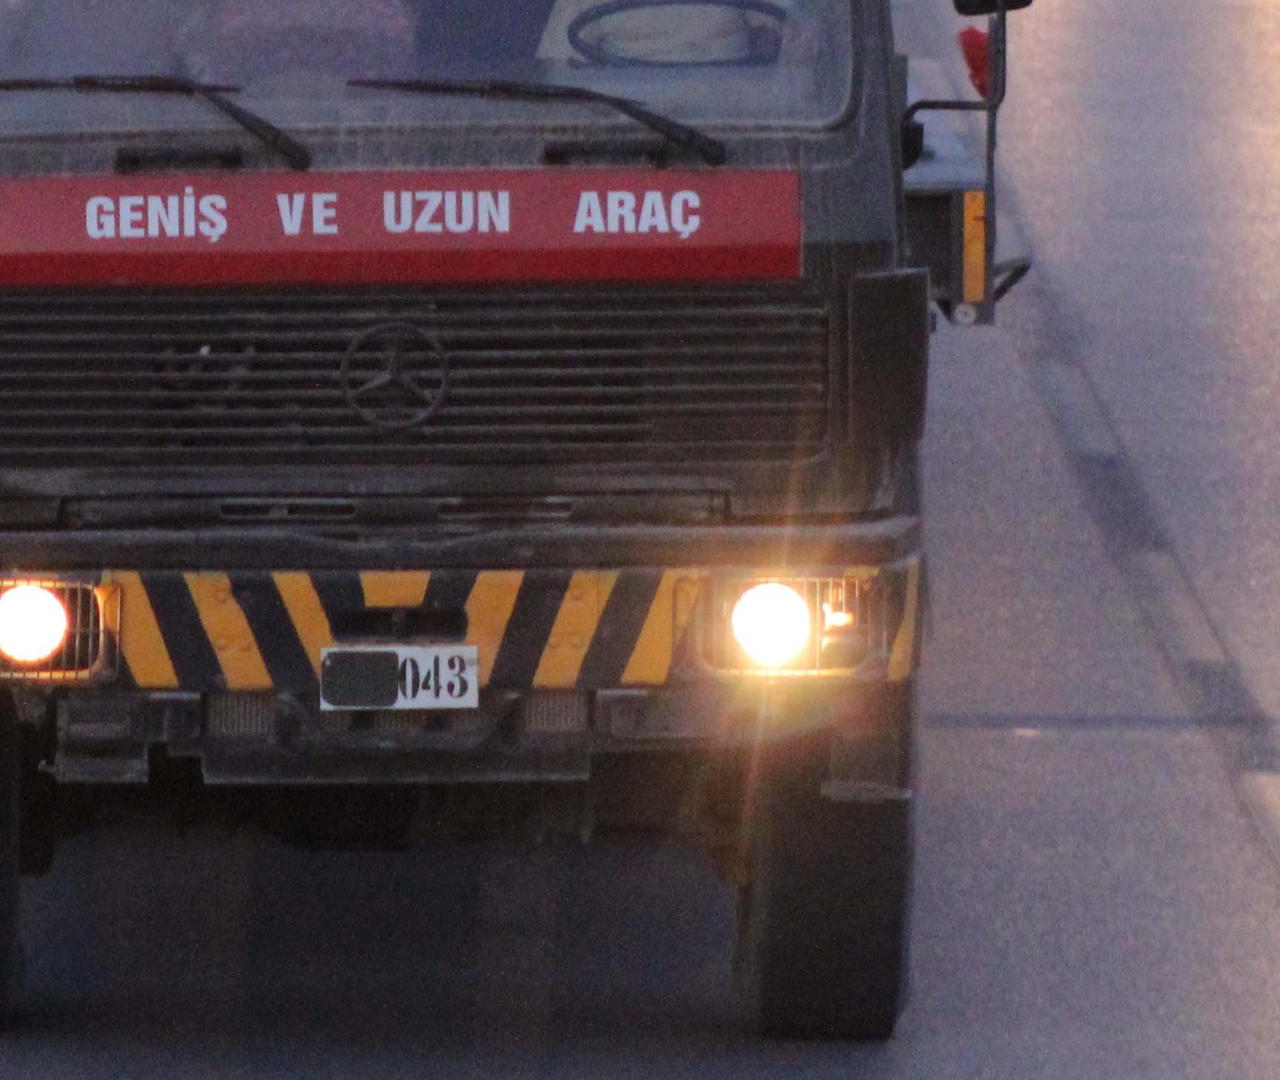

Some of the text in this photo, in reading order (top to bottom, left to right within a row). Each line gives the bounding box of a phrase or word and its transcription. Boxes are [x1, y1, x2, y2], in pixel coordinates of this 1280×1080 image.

[84, 186, 701, 242] GENİŞ VE UZUN ARAÇ
[400, 655, 468, 699] 043
